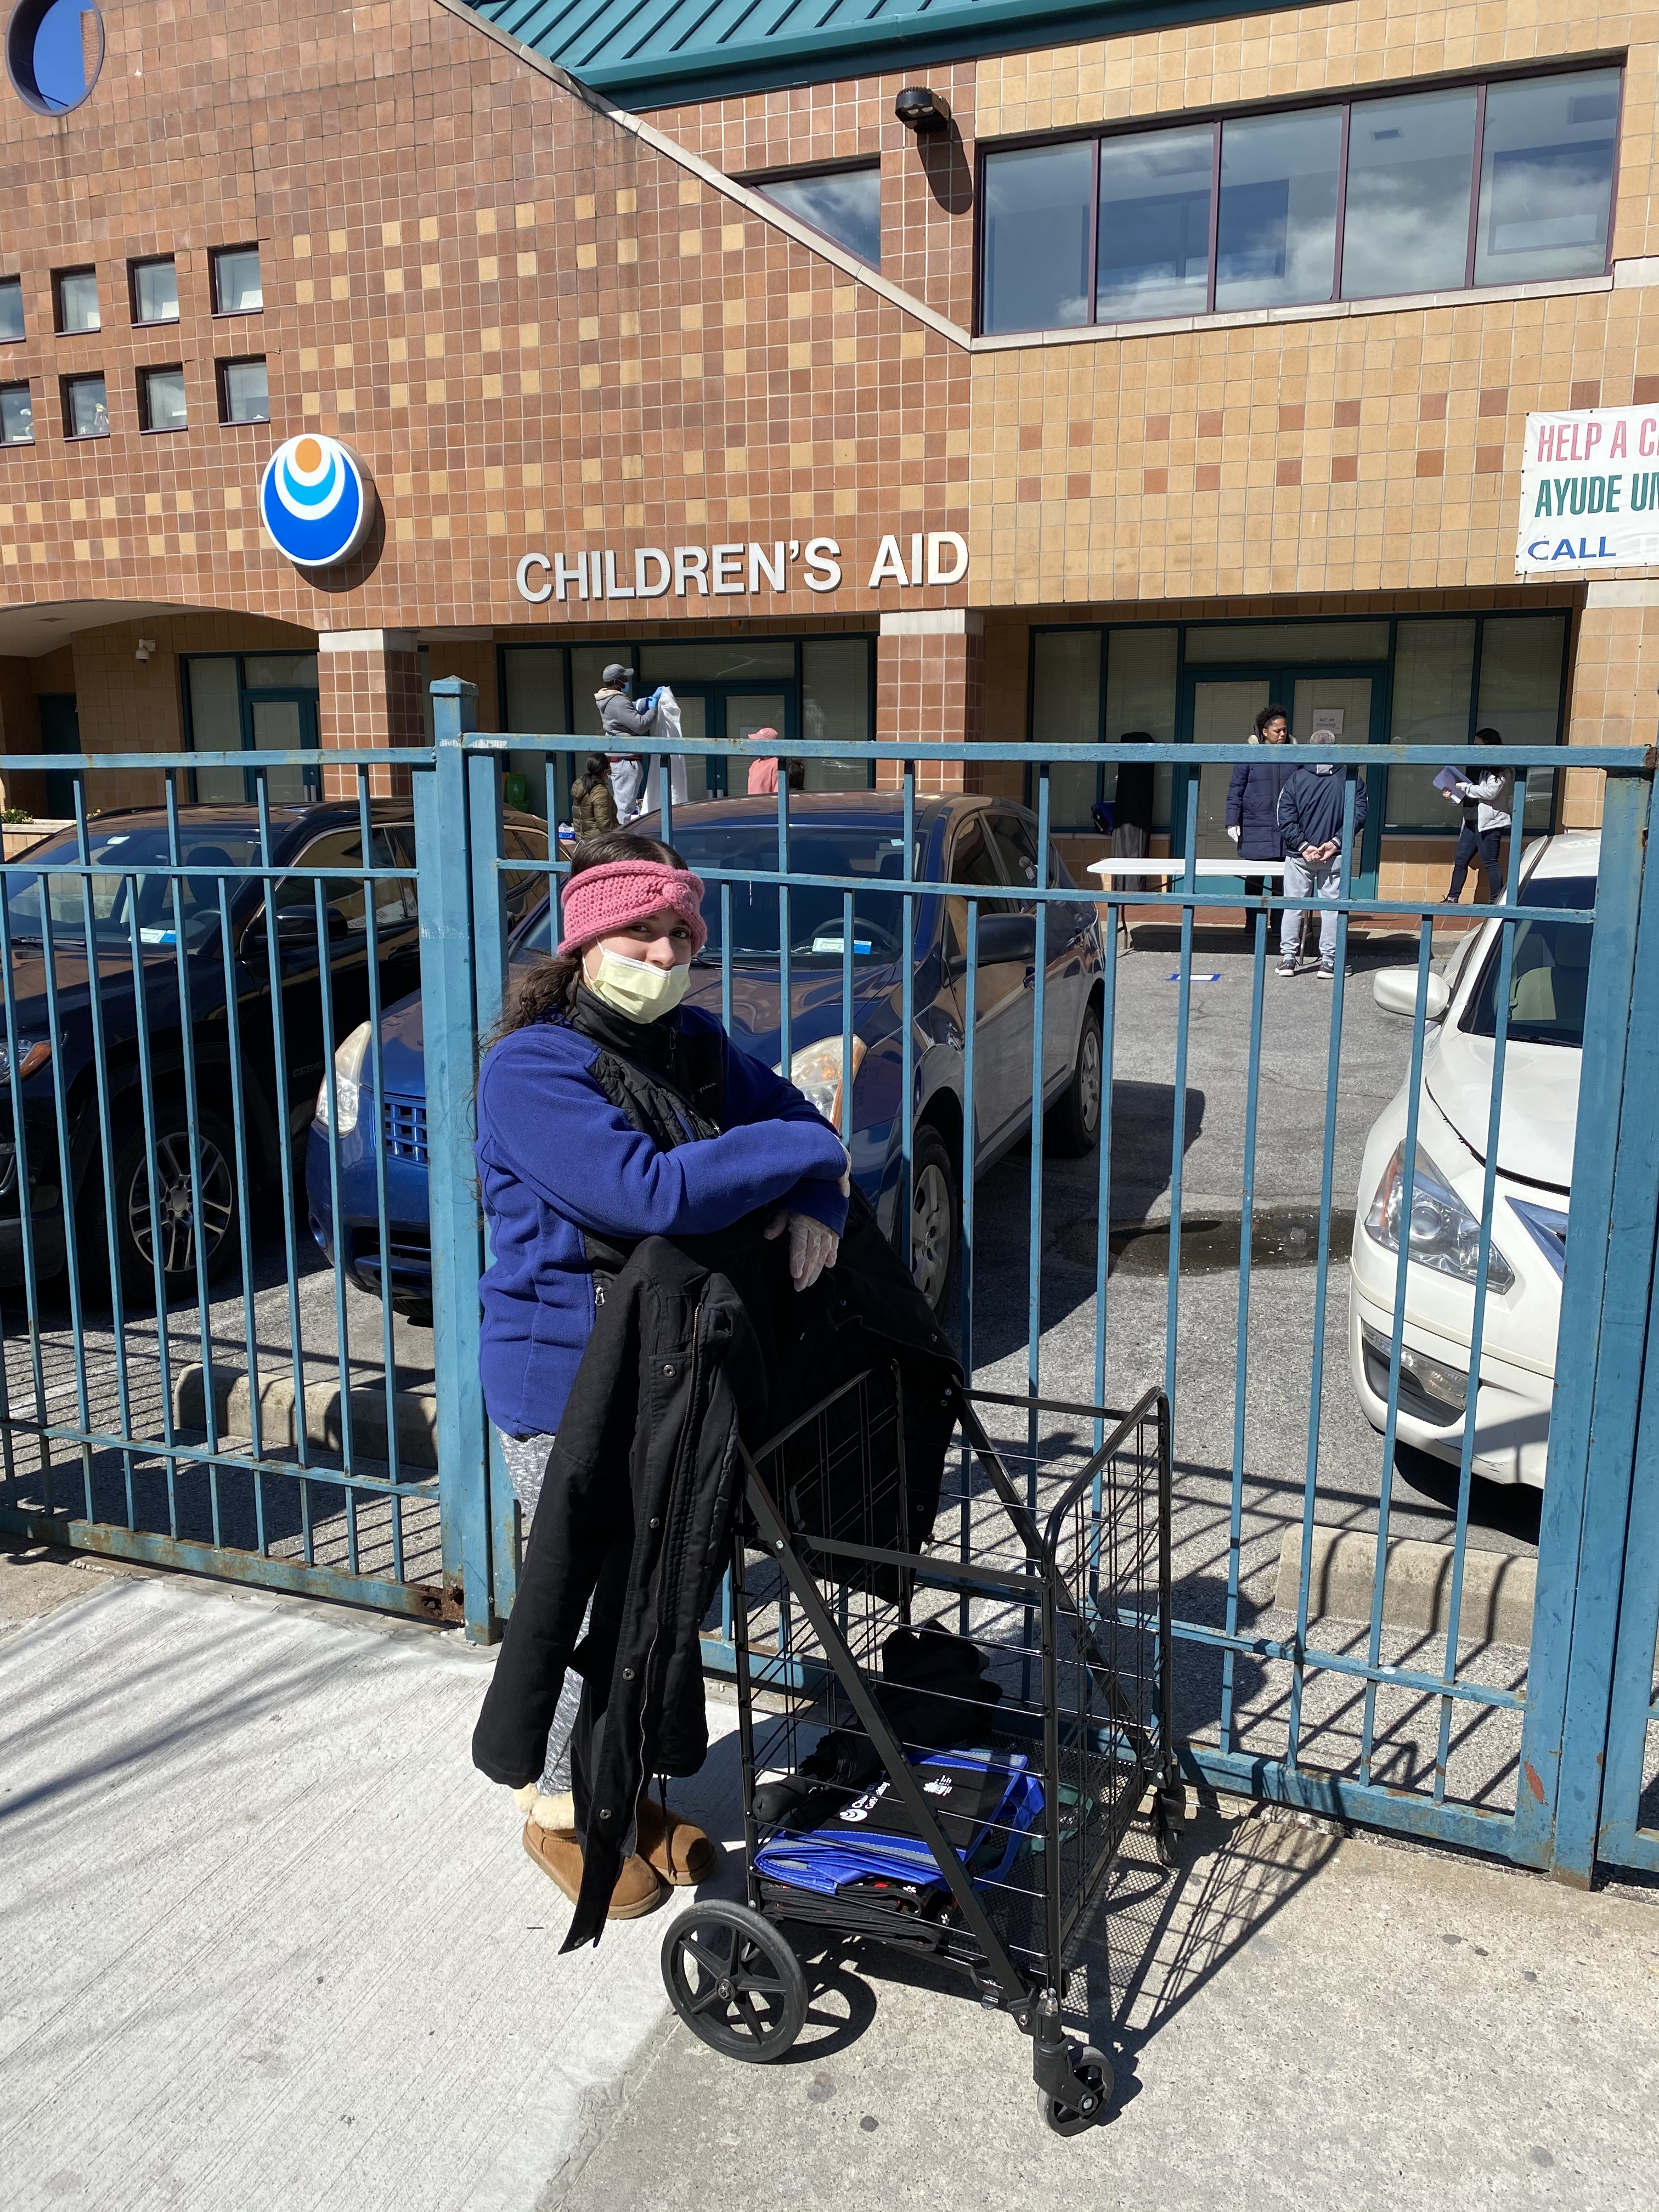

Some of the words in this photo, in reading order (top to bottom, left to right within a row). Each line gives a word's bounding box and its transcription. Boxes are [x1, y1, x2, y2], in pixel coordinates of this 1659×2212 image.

[1538, 422, 1602, 462] HELP
[1610, 420, 1627, 459] A
[1639, 417, 1659, 456] C
[1534, 474, 1622, 517] AYUDE
[516, 537, 842, 604] CHILDREN'S
[868, 531, 968, 588] AID
[1528, 536, 1617, 560] CALL
